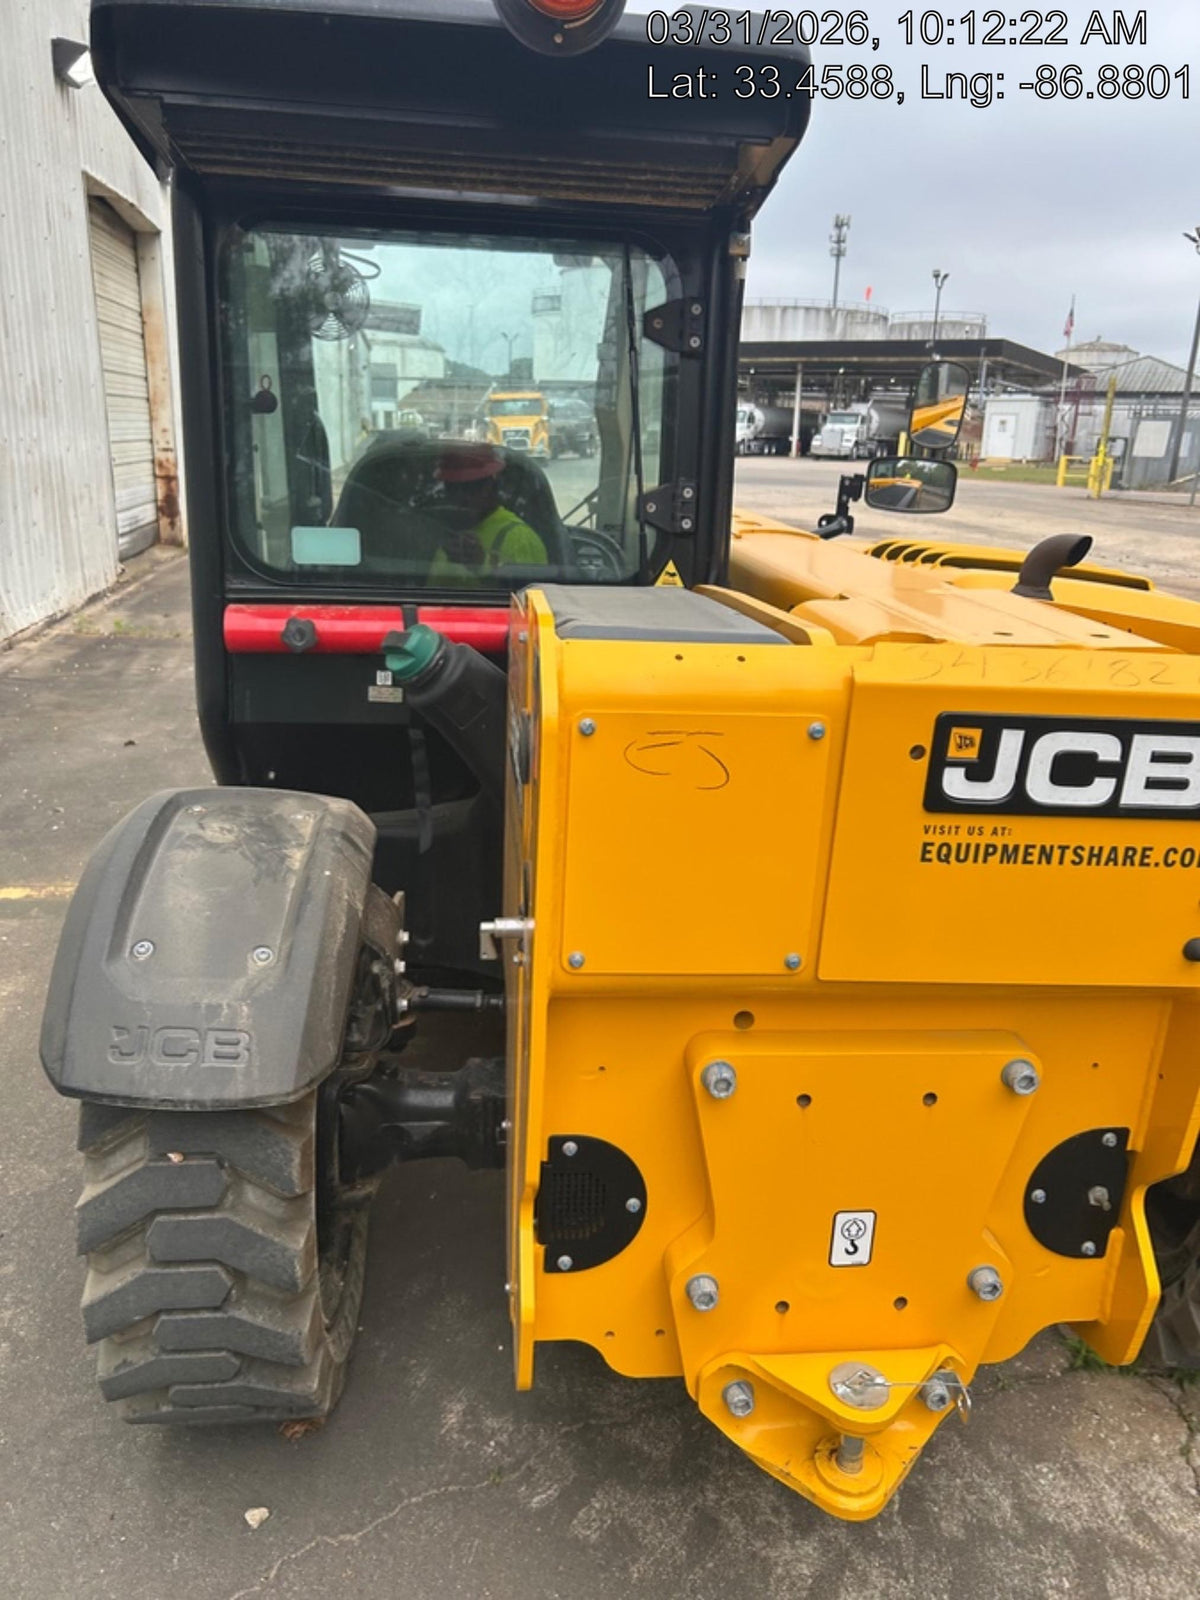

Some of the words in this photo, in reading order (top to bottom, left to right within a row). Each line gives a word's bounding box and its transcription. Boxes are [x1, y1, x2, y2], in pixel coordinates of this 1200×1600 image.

[942, 728, 1200, 809] JCB
[923, 825, 961, 836] VISIT
[967, 826, 985, 837] US
[990, 827, 1013, 837] AT:
[920, 842, 1200, 868] EQUIPMENTSHARE.CO
[107, 1025, 251, 1067] JCB
